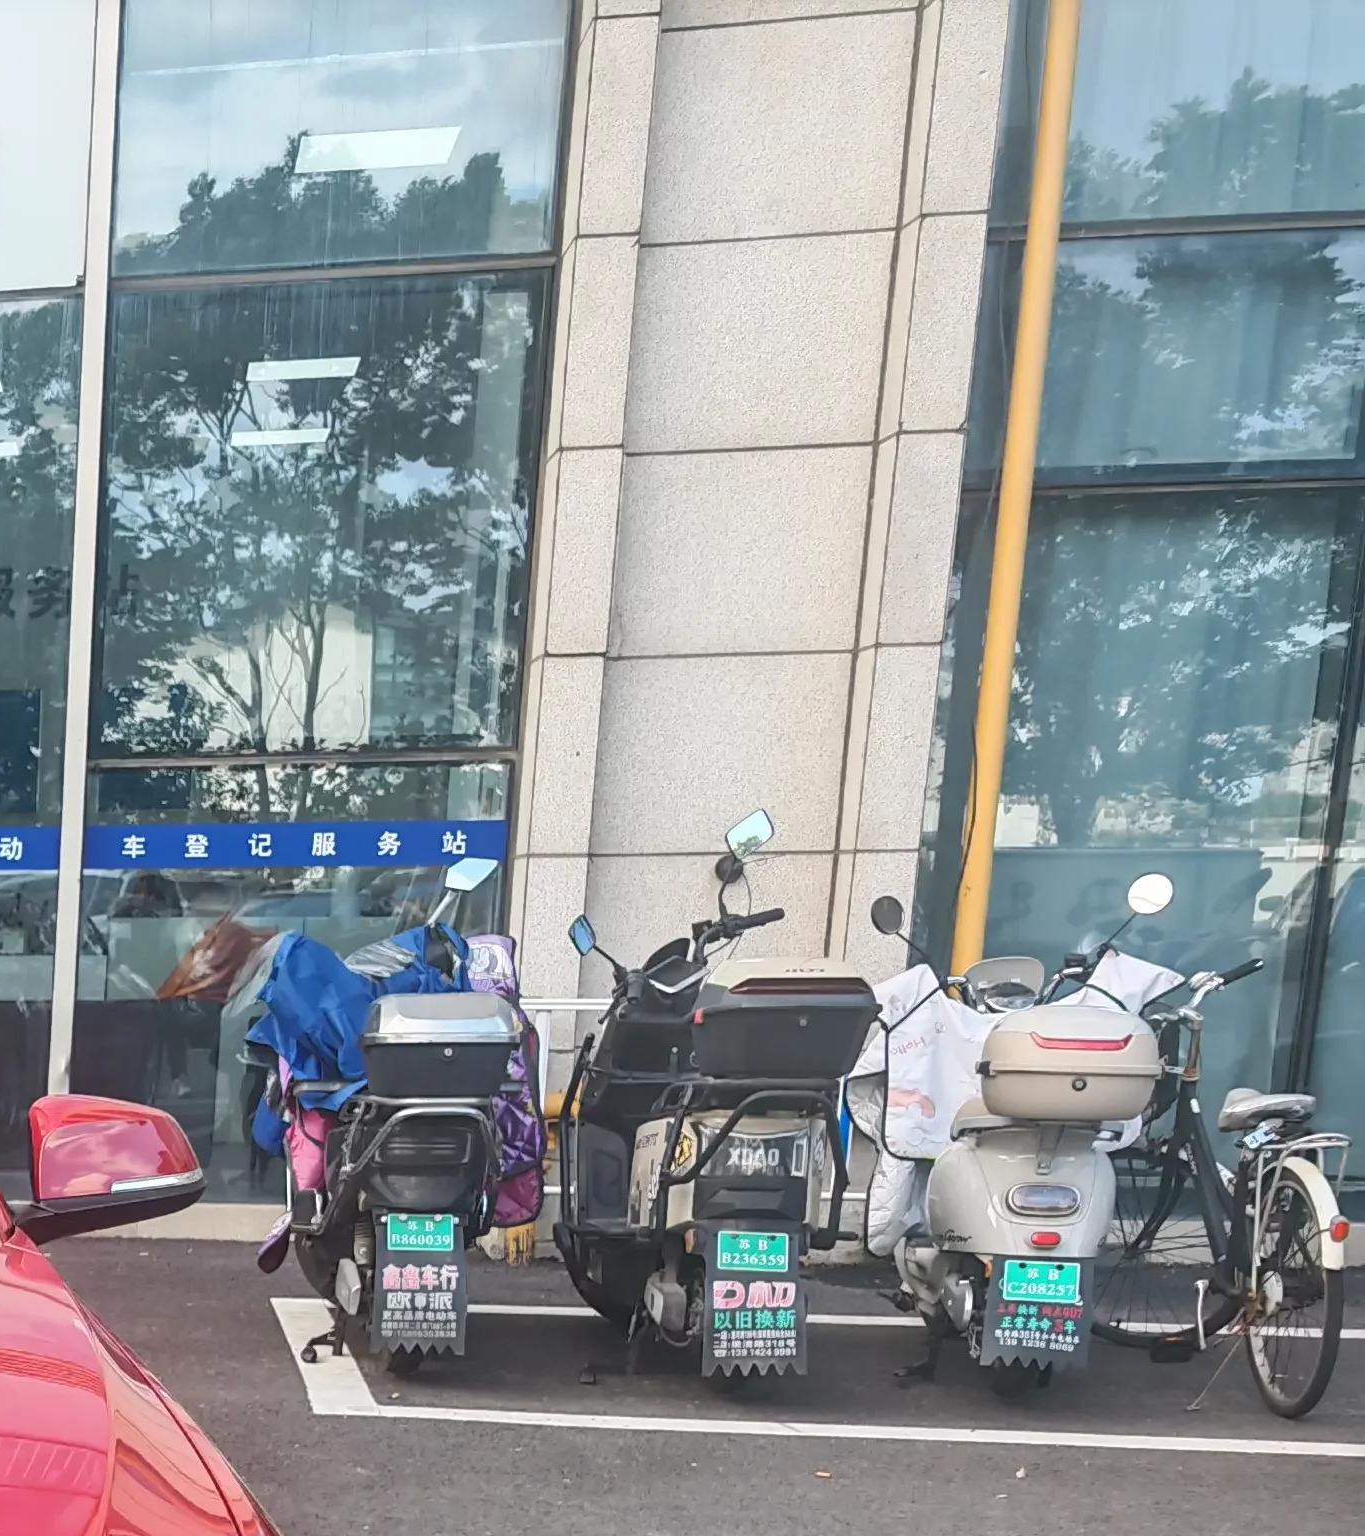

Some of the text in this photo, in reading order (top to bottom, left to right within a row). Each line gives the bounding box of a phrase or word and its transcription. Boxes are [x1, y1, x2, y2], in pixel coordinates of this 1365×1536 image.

[122, 831, 467, 858] 车登记服务站
[722, 1252, 785, 1266] B236359
[1007, 1281, 1076, 1297] C208257
[713, 1309, 797, 1329] 以旧换新
